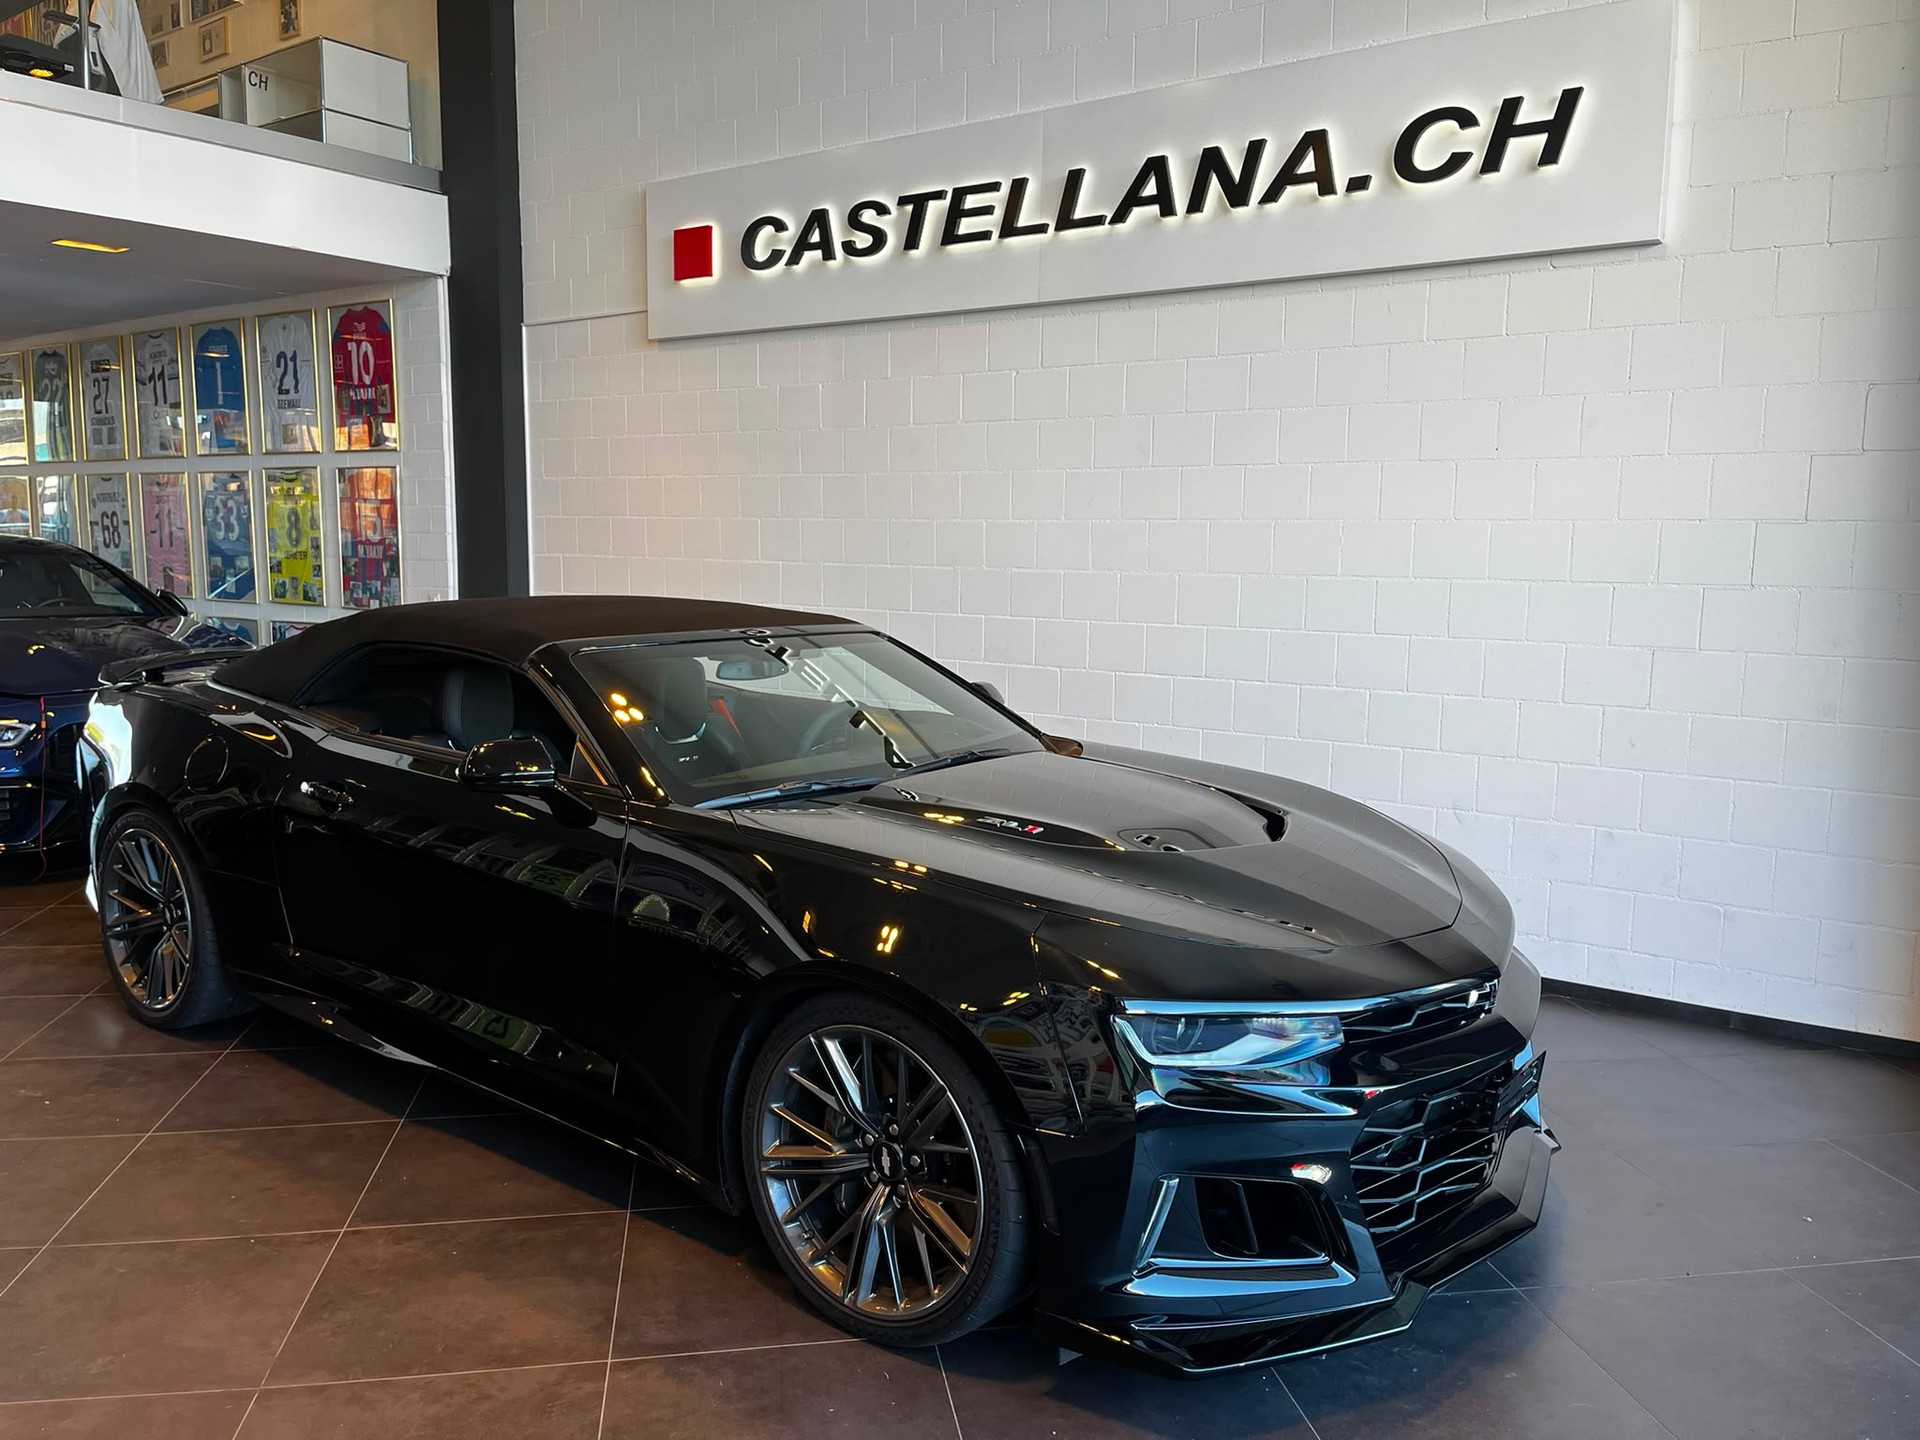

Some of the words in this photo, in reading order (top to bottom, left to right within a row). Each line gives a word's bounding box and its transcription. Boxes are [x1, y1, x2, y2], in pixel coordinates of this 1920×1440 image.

[248, 70, 268, 91] CH
[740, 86, 1585, 271] CASTELLANA.CH
[276, 349, 300, 395] 21
[347, 340, 375, 386] 10
[93, 376, 110, 415] 27
[147, 364, 168, 407] 11
[101, 510, 121, 550] 68
[155, 508, 174, 549] 11
[214, 497, 239, 541] 33
